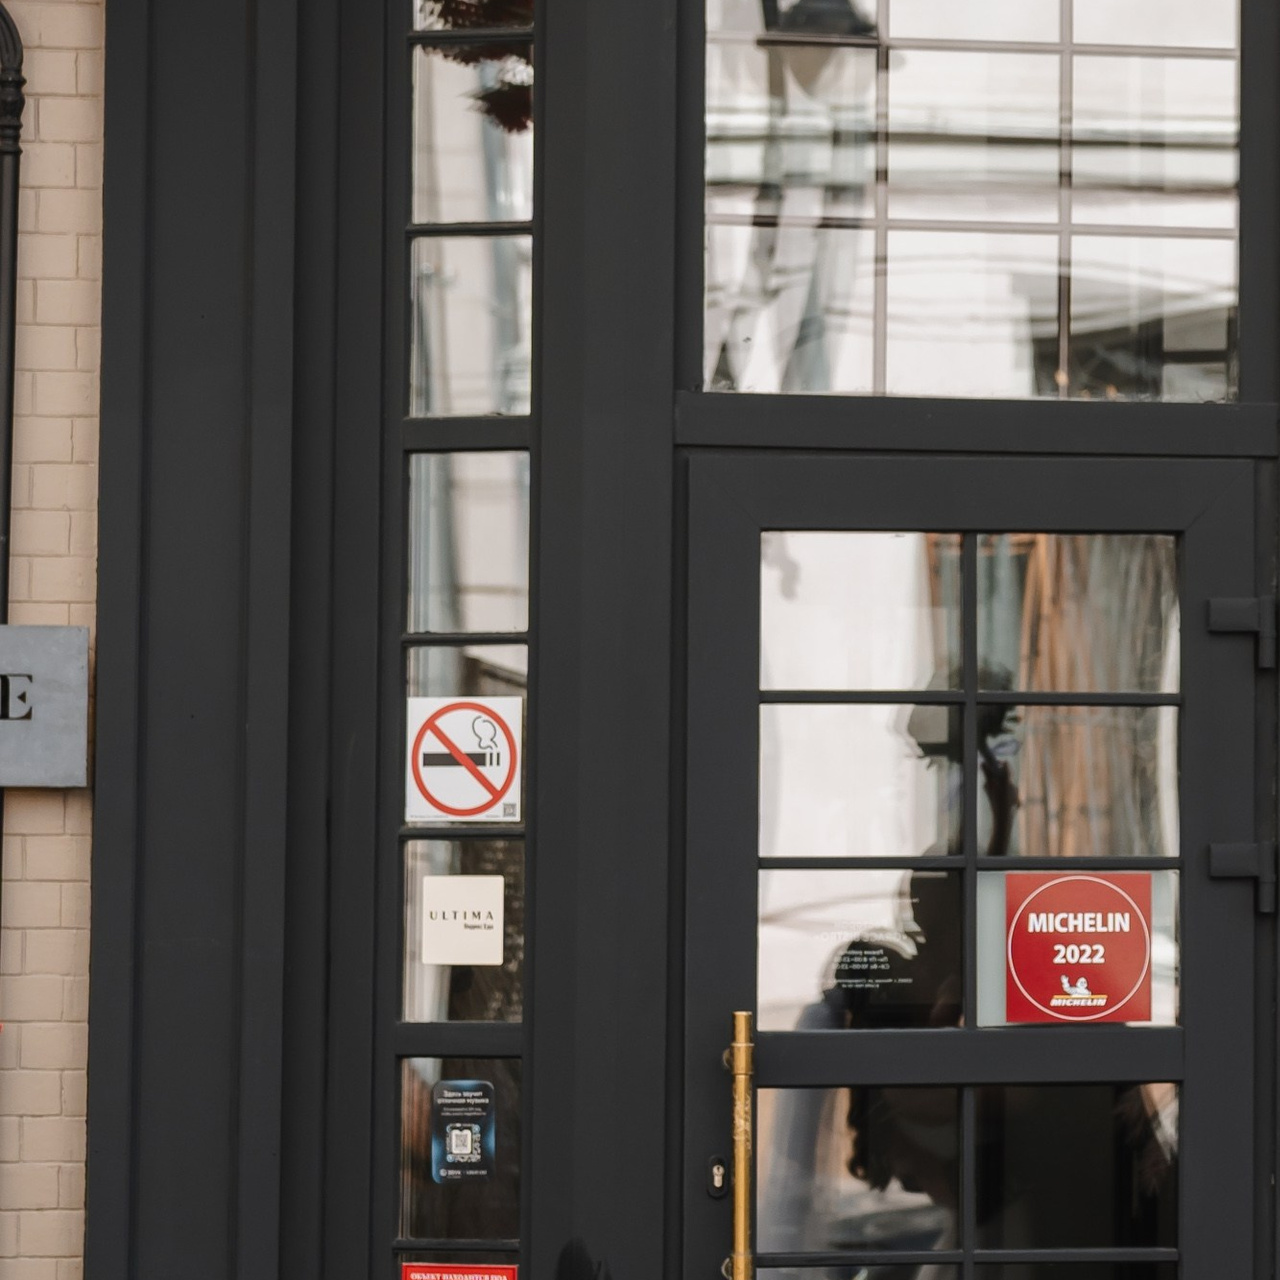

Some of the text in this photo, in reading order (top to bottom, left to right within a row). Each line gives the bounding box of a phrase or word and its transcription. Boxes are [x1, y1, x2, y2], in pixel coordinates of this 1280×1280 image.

[429, 910, 494, 921] ULTIMA
[1027, 912, 1131, 933] MICHELIN
[1053, 943, 1105, 964] 2022
[1050, 998, 1107, 1007] MICHELIN
[410, 1273, 441, 1280] ОБЪЕКТ
